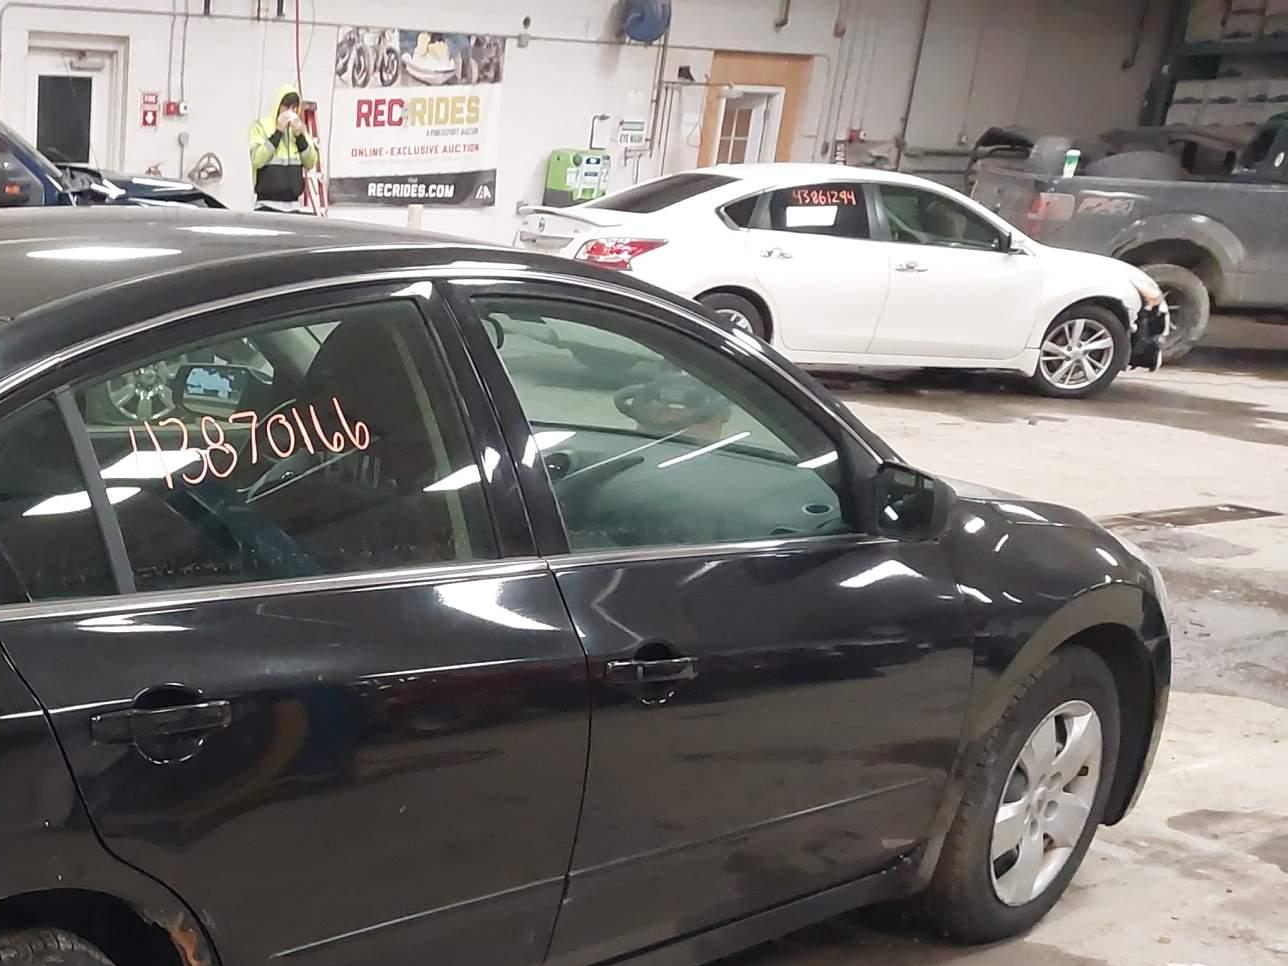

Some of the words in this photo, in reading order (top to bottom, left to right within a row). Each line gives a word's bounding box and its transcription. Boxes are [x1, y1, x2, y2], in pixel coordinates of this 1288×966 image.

[356, 98, 404, 128] REC
[408, 96, 480, 126] RIDES
[442, 143, 480, 153] AUCTION
[368, 183, 455, 198] RECRIDES.COM
[792, 189, 857, 206] 43861294
[128, 397, 370, 489] 43870166
